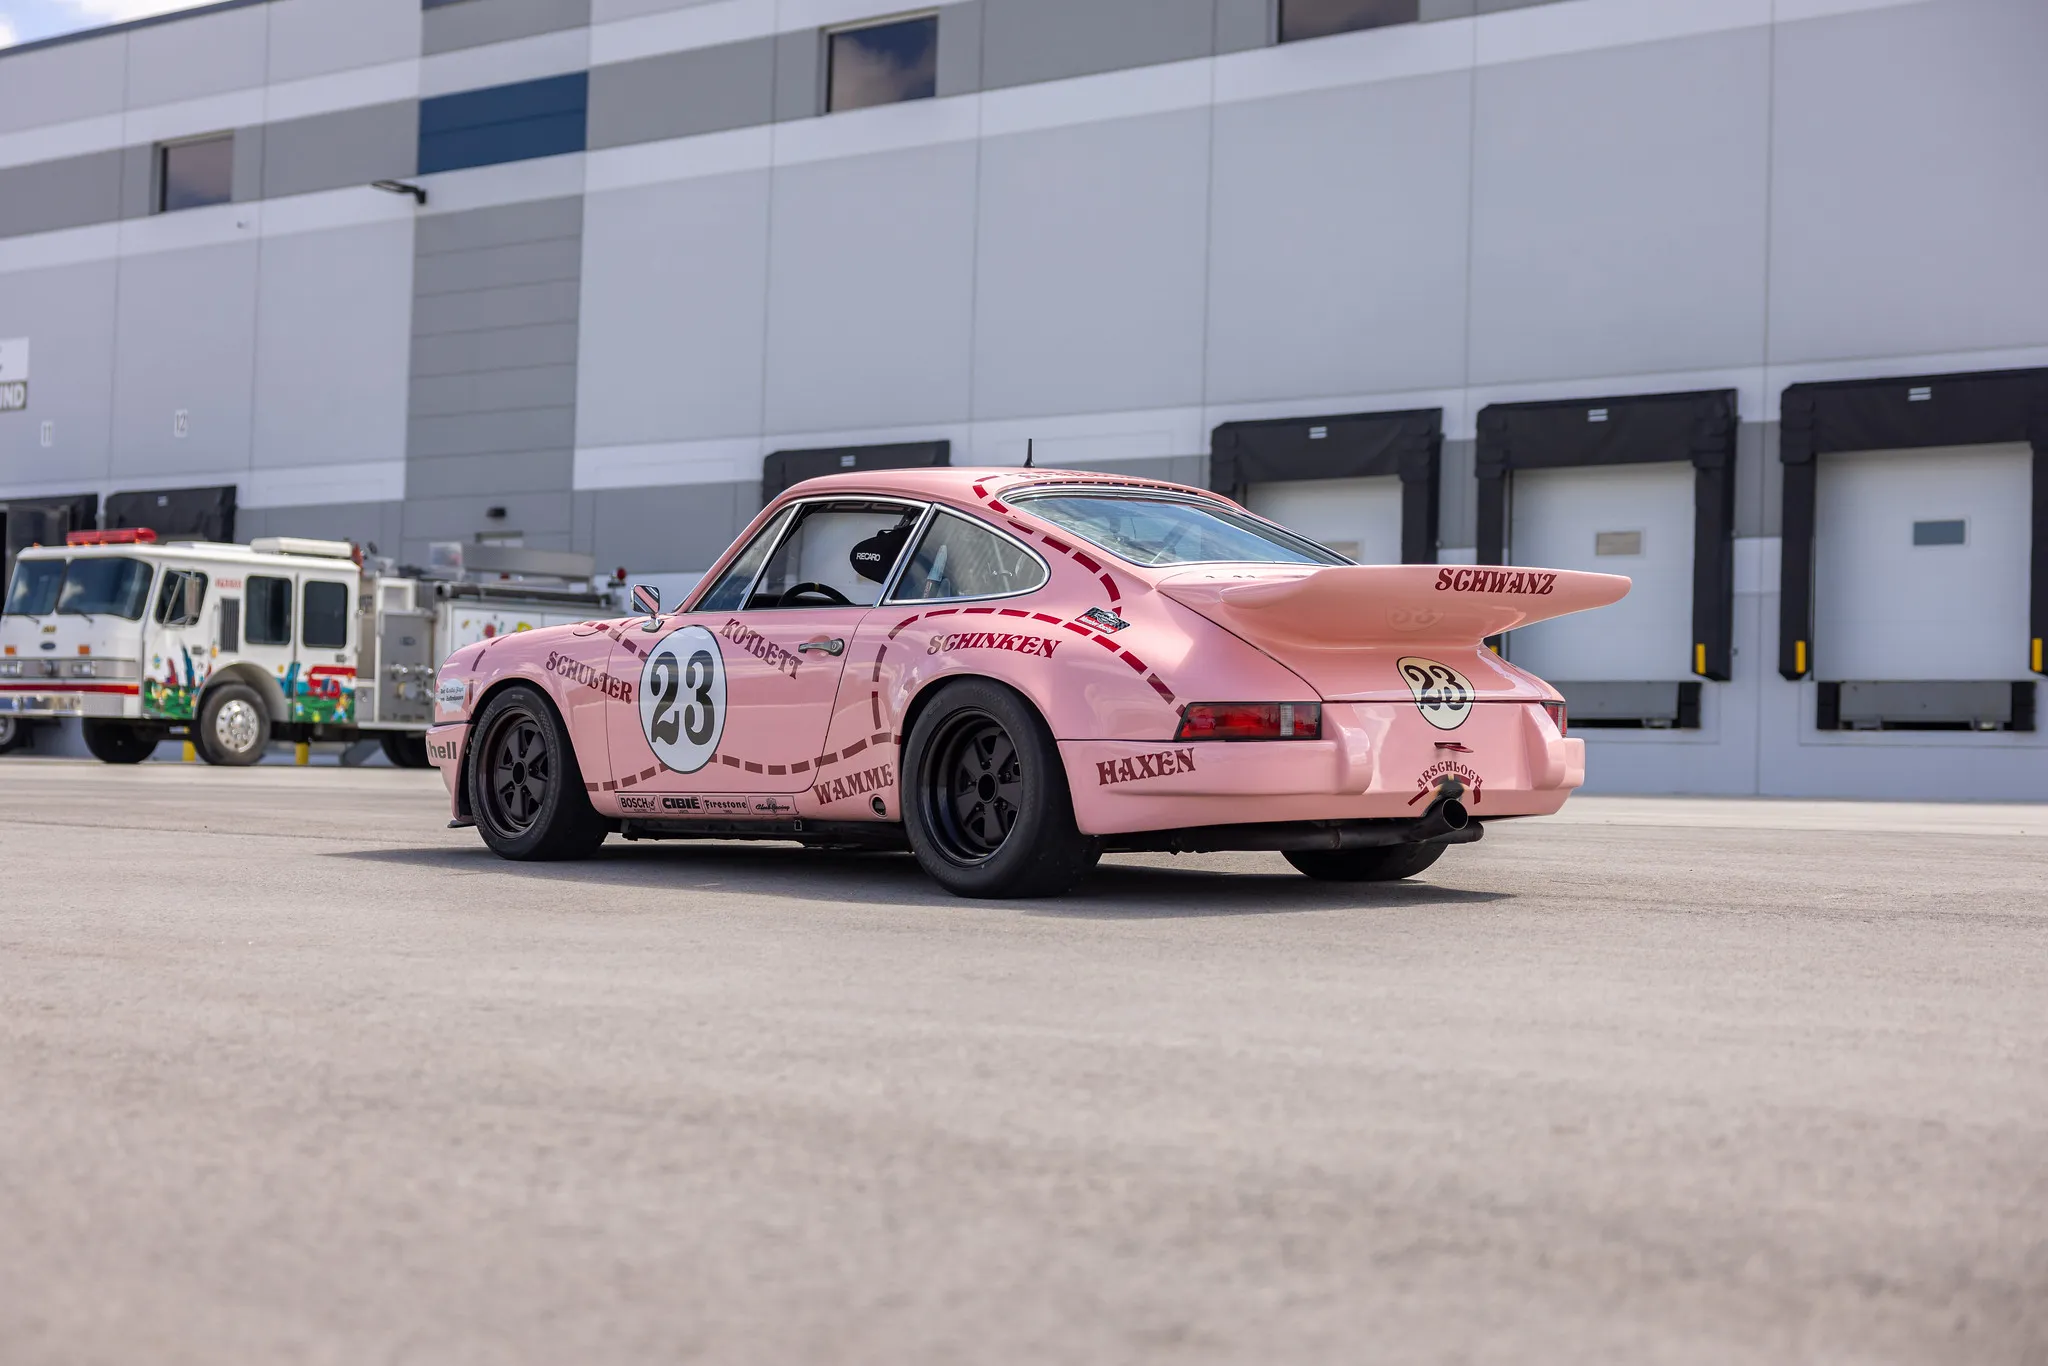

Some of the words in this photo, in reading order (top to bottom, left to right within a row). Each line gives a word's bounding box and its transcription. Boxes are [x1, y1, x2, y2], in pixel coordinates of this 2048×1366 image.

[856, 552, 881, 562] RECARO
[1435, 568, 1557, 595] SCHWANZ
[719, 618, 803, 680] KOTLETT
[927, 632, 1062, 659] SCHINKEN
[546, 651, 632, 704] SCHULTER
[1403, 665, 1467, 711] 23
[650, 650, 715, 745] 23
[427, 740, 457, 760] hell
[1096, 747, 1196, 786] HAXEN
[1417, 760, 1483, 790] ARSCHLOCH
[813, 763, 894, 806] WAMME
[620, 797, 648, 808] BOSCH
[704, 799, 747, 809] Firestone
